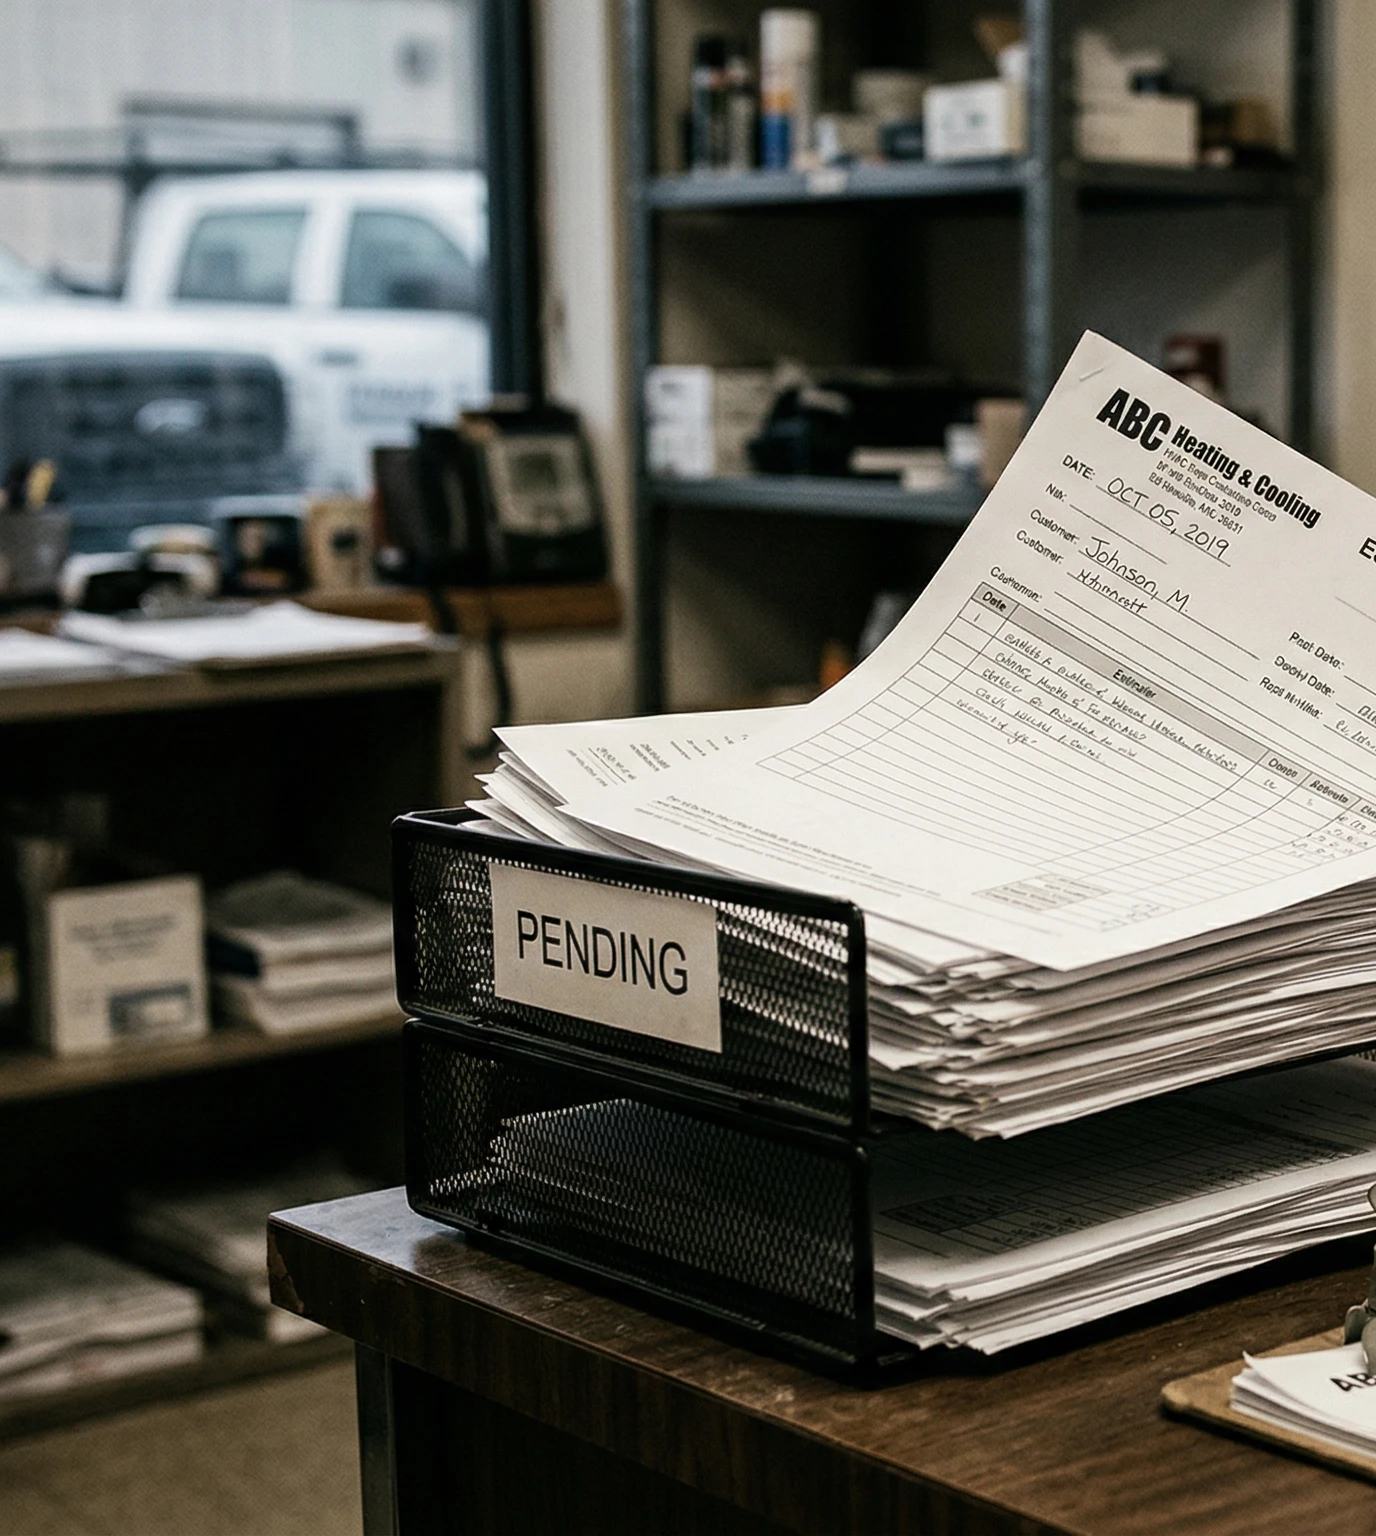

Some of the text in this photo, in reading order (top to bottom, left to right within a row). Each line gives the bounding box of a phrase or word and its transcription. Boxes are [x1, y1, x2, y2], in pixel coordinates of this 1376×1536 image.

[1062, 454, 1096, 481] DATE:
[1096, 387, 1171, 452] ABC
[1170, 424, 1240, 480] Heating
[1238, 469, 1254, 488] &
[1253, 474, 1322, 529] Cooling
[1106, 476, 1149, 508] OCT
[1184, 523, 1231, 559] 2019
[1085, 536, 1159, 600] Johnson,
[1166, 589, 1190, 612] M.
[516, 909, 689, 996] PENDING
